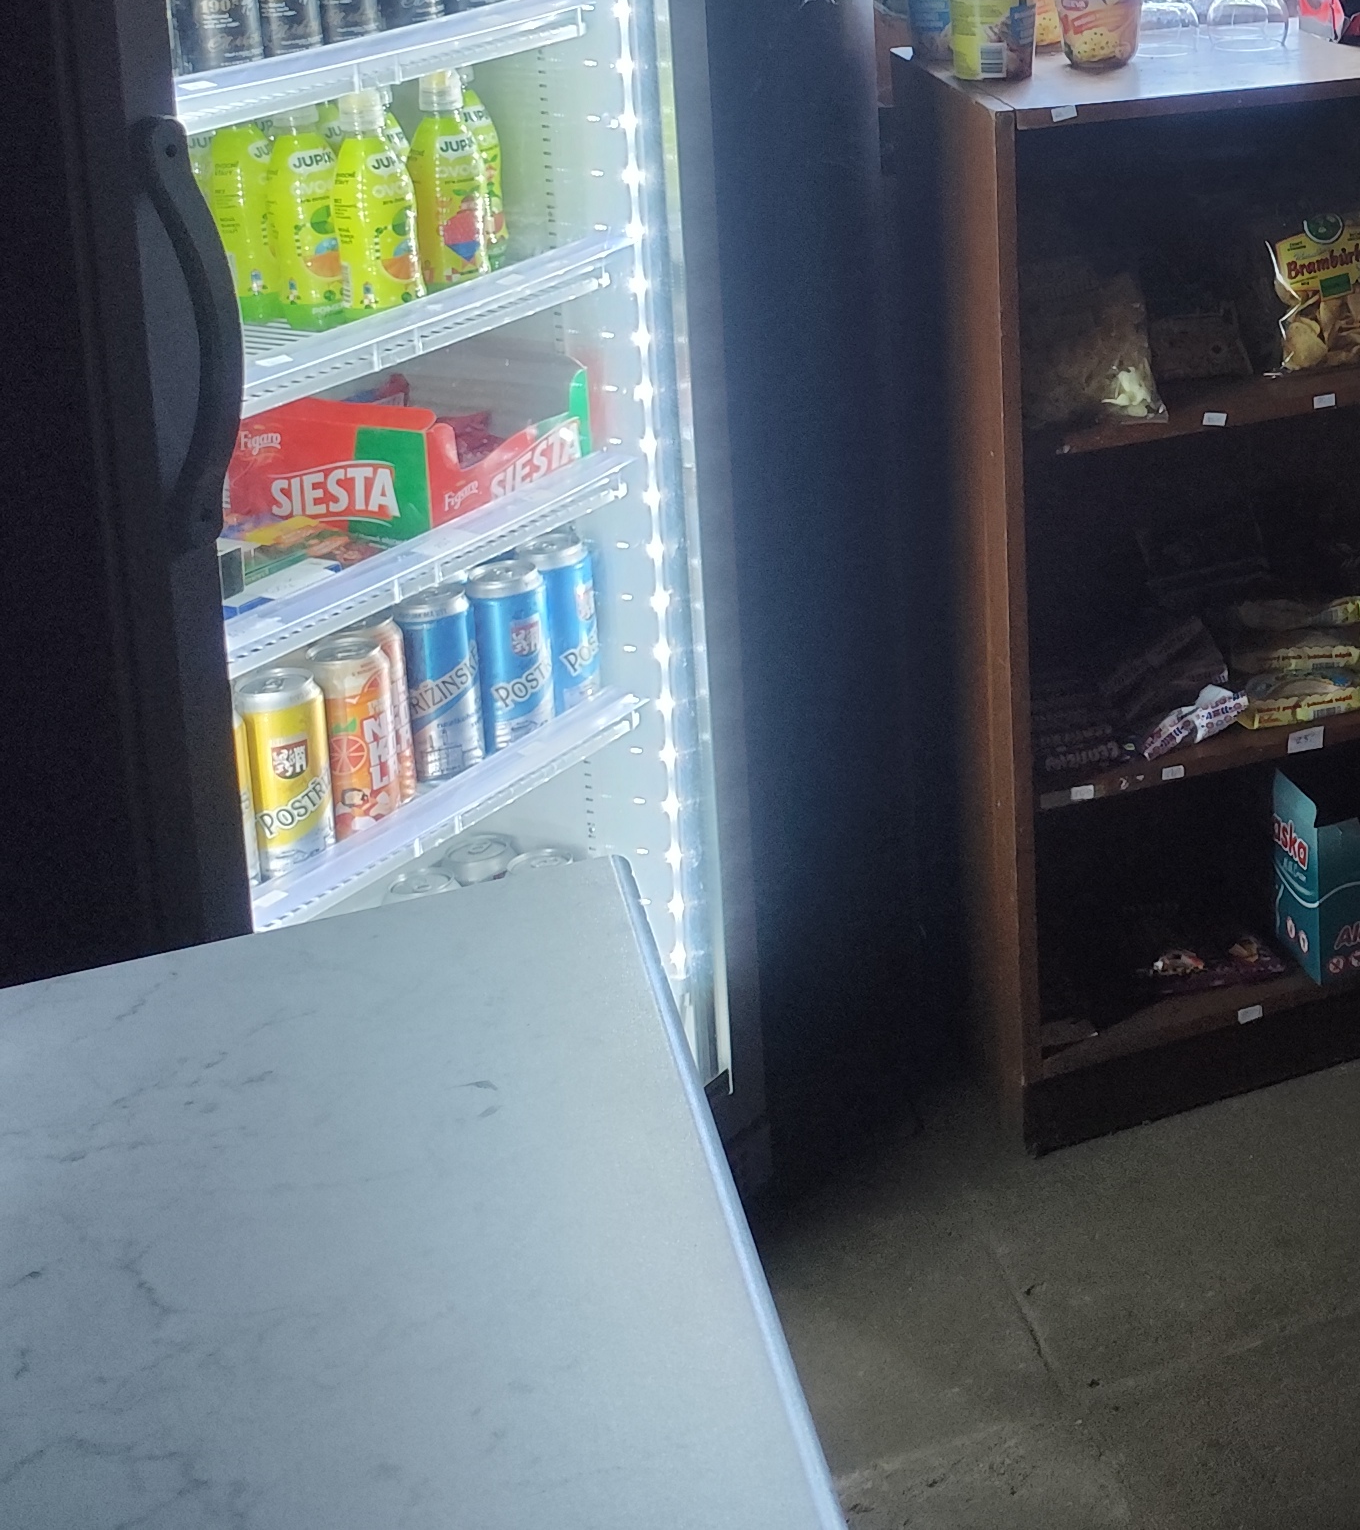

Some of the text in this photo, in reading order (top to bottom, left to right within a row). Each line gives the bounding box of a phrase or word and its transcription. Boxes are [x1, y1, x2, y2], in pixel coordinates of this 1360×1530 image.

[239, 430, 282, 456] Figaro
[489, 427, 583, 502] SIESTA
[271, 466, 401, 518] SIESTA
[444, 479, 479, 512] Figaro
